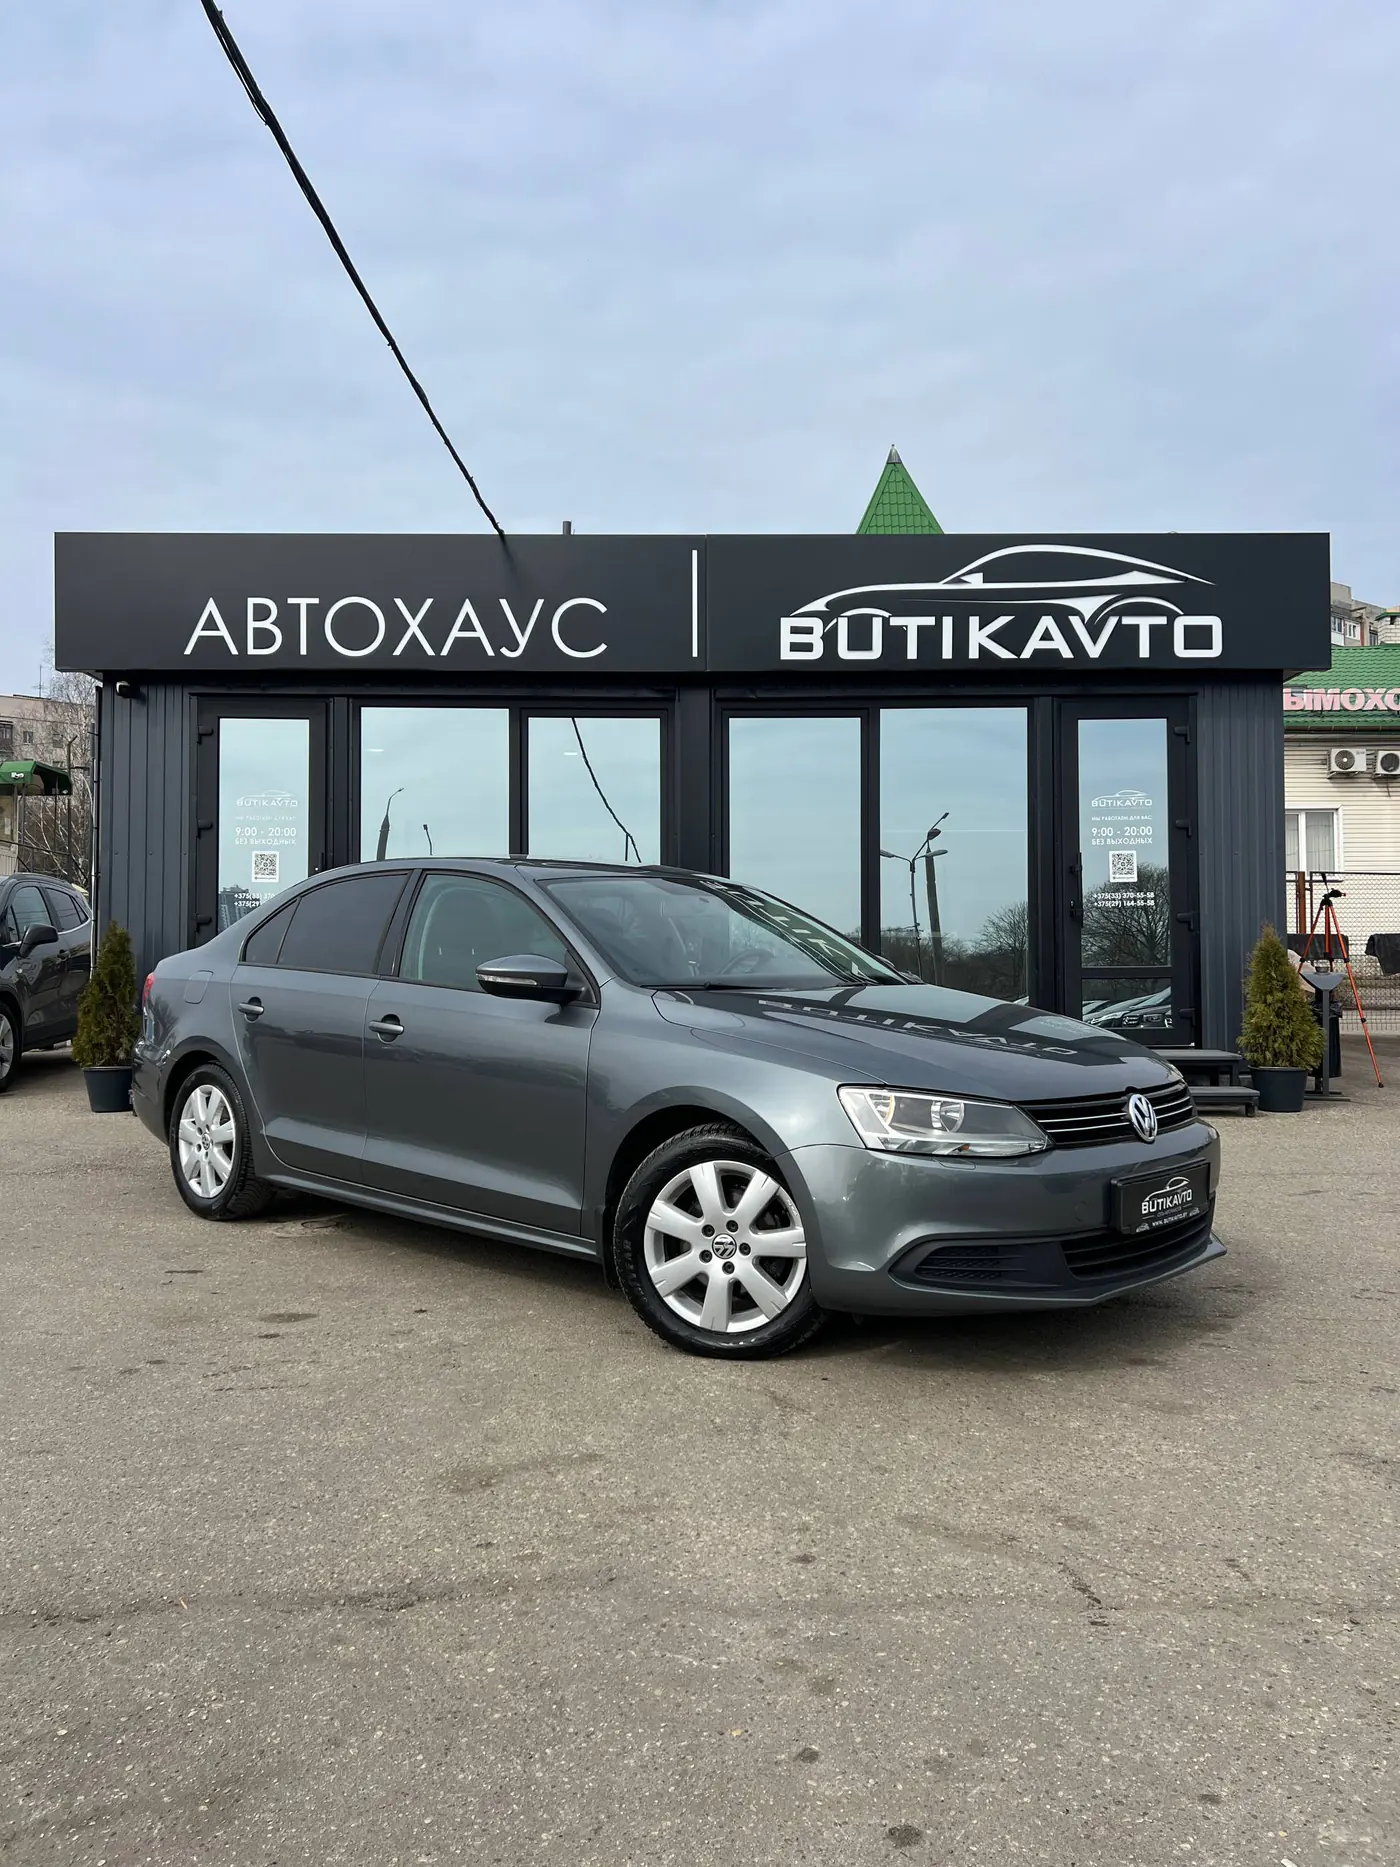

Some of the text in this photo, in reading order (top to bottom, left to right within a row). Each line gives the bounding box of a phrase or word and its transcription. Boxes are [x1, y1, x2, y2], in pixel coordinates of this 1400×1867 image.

[184, 596, 608, 659] АВТОХАУС
[780, 613, 1223, 660] BUTIKAVTO
[236, 799, 298, 807] BUTIKAVTO
[1091, 799, 1153, 807] BUTIKAVTO
[235, 827, 258, 837] 9:00
[268, 827, 297, 837] 20:00
[1091, 827, 1114, 837] 9:00
[1124, 826, 1153, 836] 20:00
[235, 838, 296, 846] БЕЗ ВЫХОДНЫХ
[1091, 837, 1153, 846] БЕЗ ВЫХОДНЫХ
[1141, 1189, 1193, 1214] BUTIKAVTO
